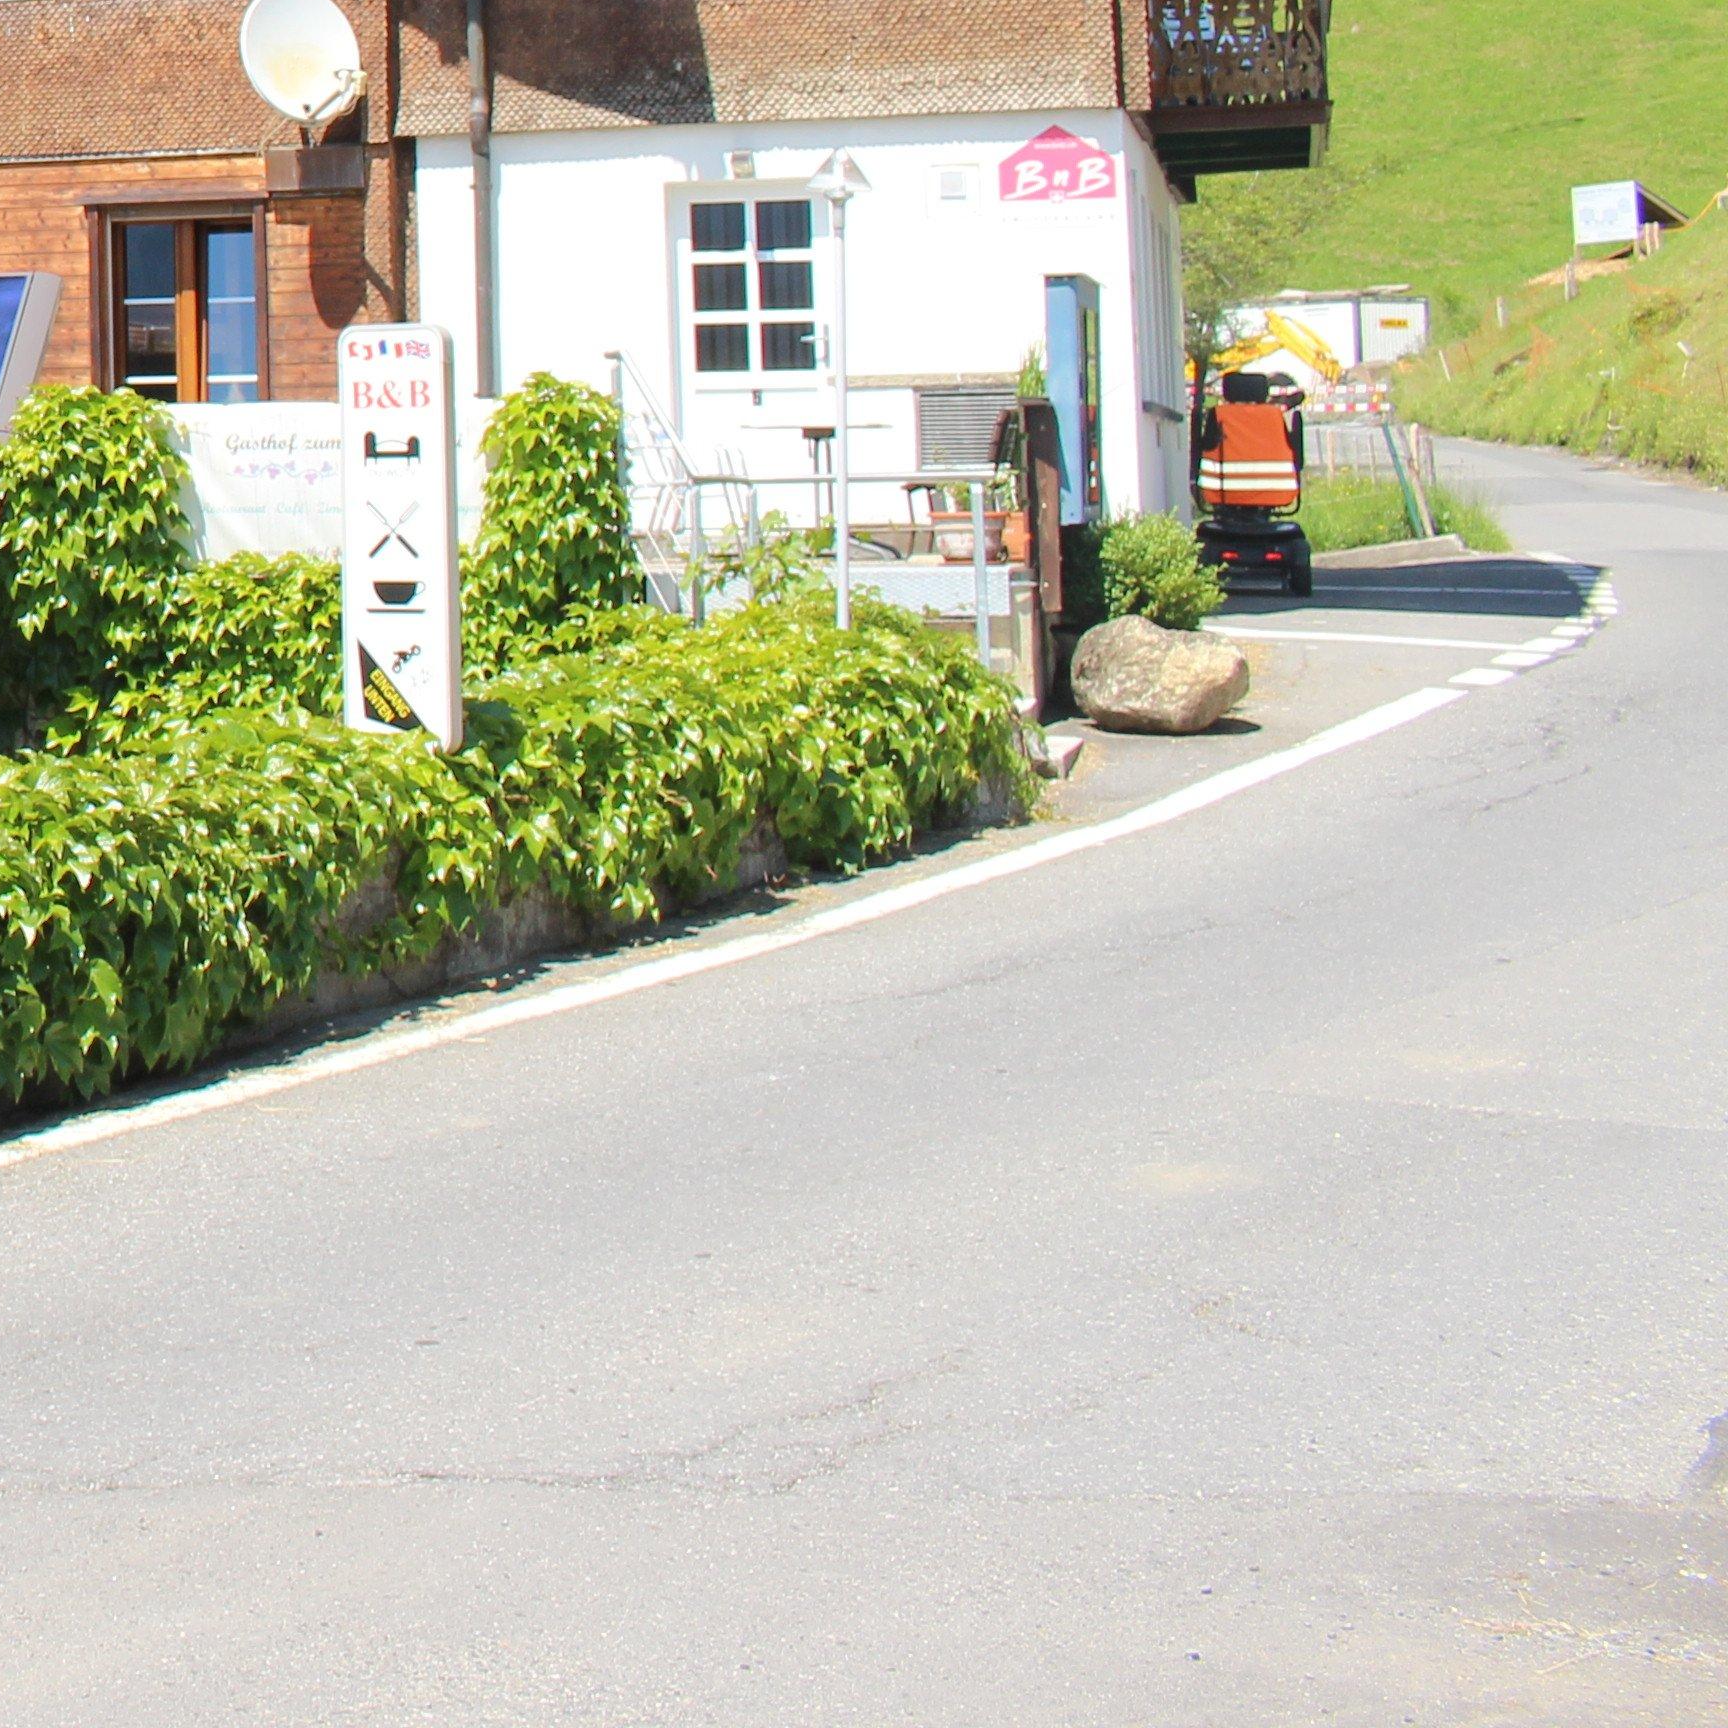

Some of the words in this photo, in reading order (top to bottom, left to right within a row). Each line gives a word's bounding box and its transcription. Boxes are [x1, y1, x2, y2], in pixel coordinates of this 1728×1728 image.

[352, 380, 431, 409] B&B
[225, 432, 298, 455] Gasthof
[304, 438, 342, 451] zum
[364, 684, 396, 723] UNTEN
[369, 668, 411, 719] EINGANG
